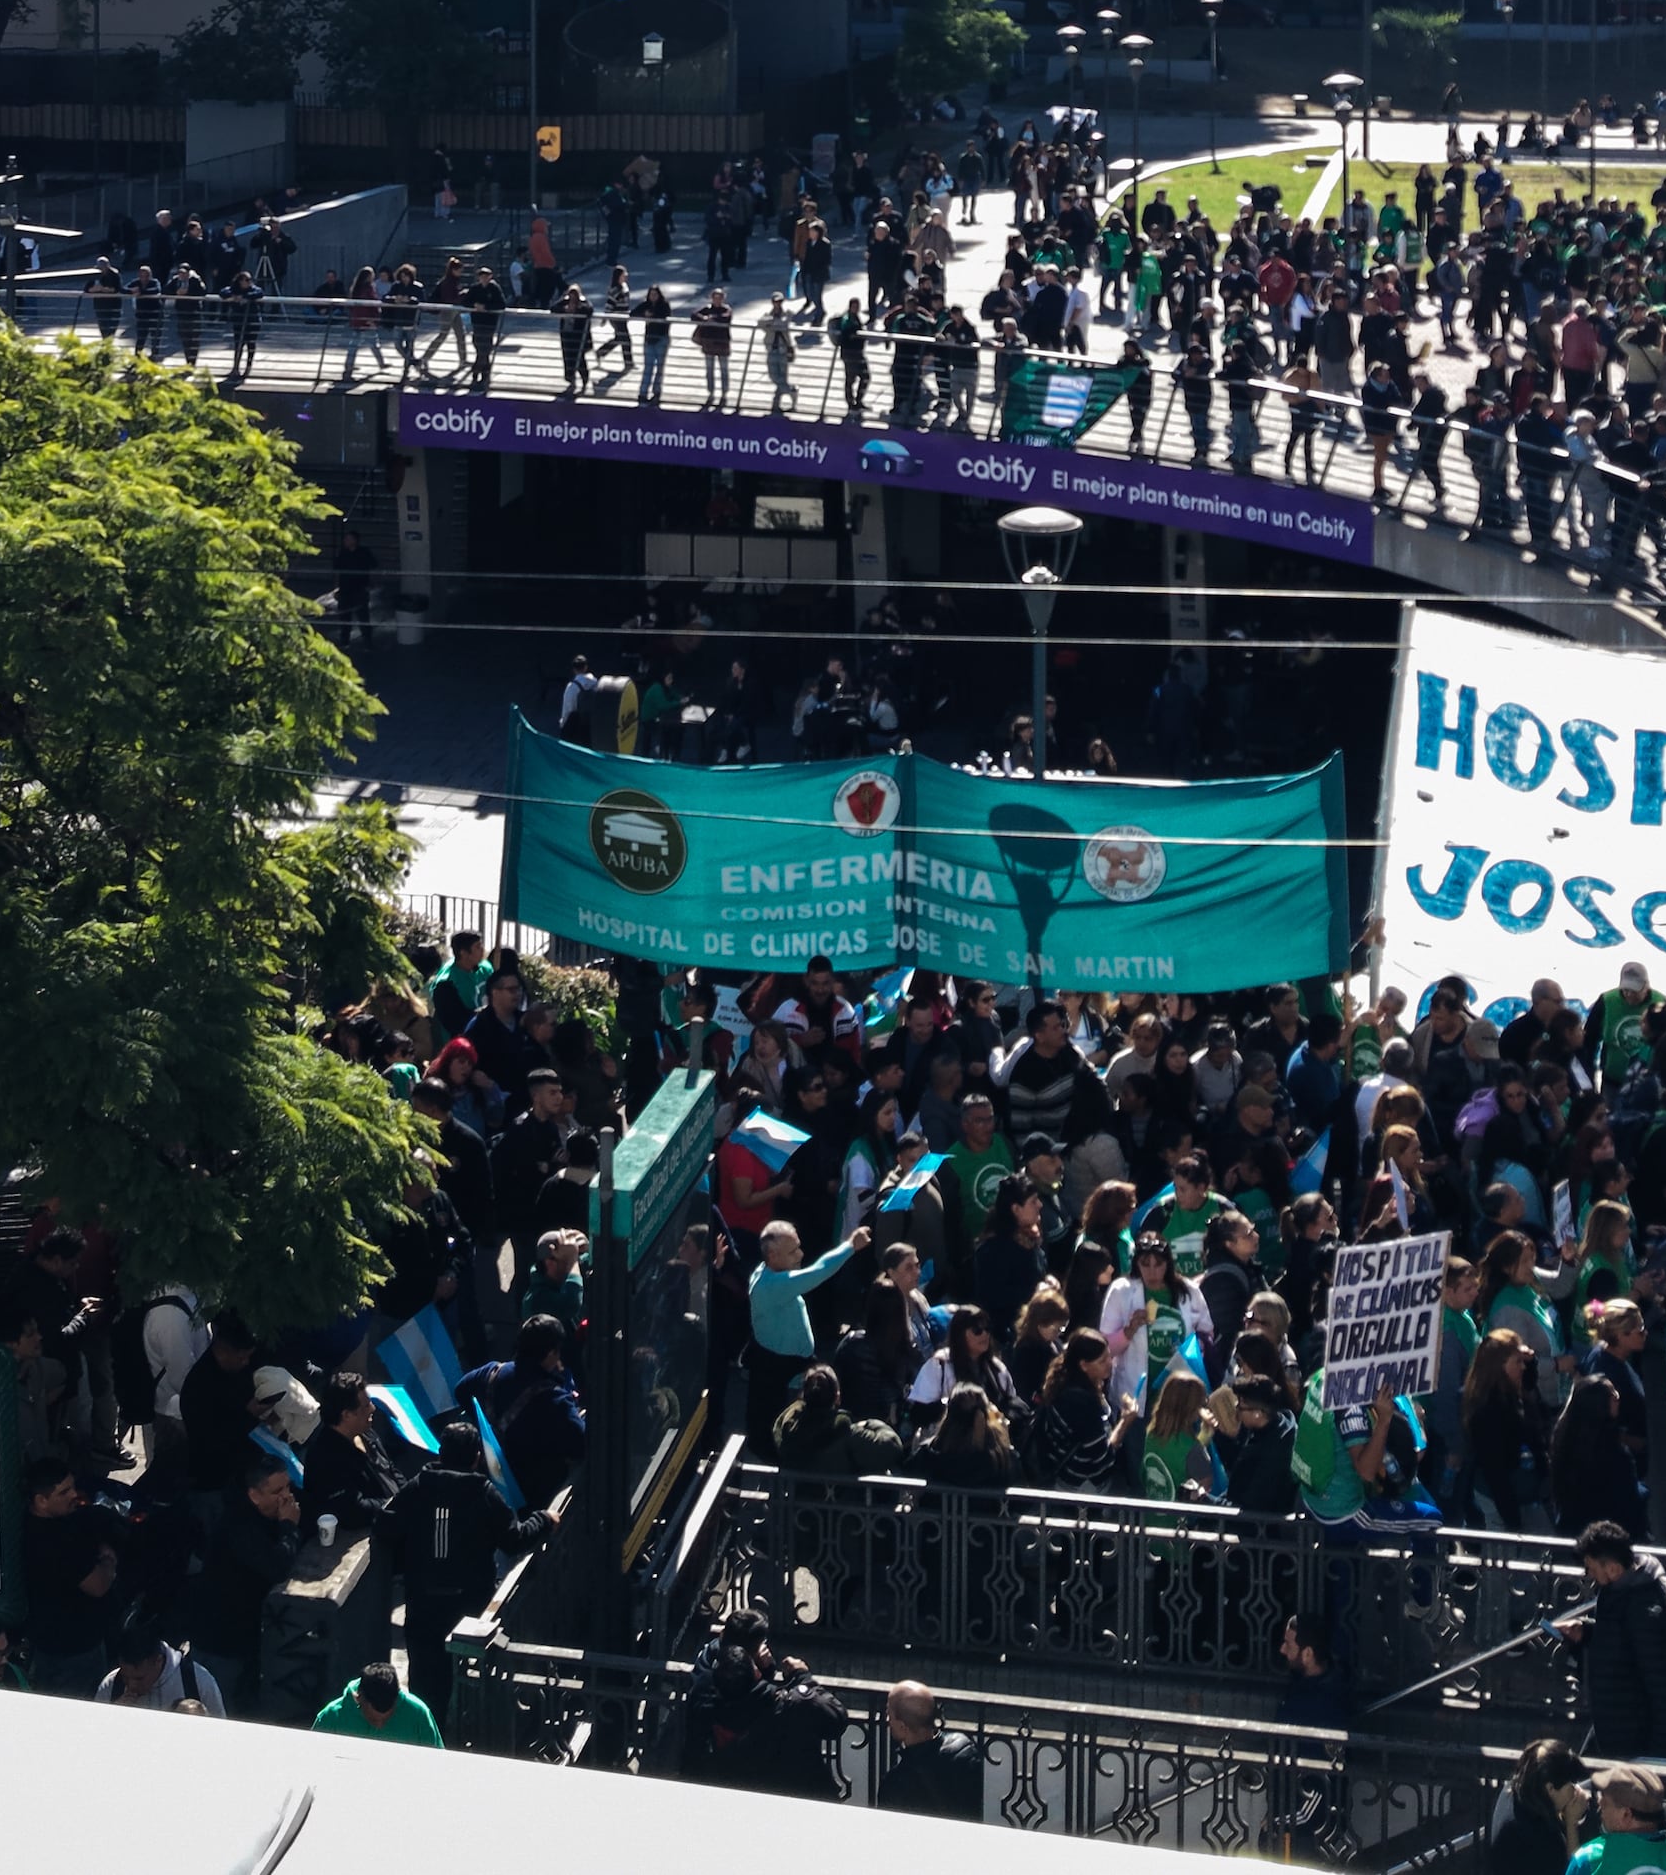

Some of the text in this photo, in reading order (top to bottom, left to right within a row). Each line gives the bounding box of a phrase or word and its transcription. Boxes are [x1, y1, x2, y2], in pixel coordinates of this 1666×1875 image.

[415, 408, 829, 464] cabify El mejor plan termina en un Cabify
[957, 454, 1355, 546] cabify El mejor plan termina en un Cabify
[607, 849, 670, 877] APUBA
[721, 849, 998, 903] ENFERMERIA
[721, 896, 997, 934] COMISION INTERNA
[578, 907, 1176, 980] HOSPITAL DE CLINICAS JOSE DE SAN MARTIN
[1335, 1240, 1444, 1287] HOSPITAL
[1334, 1294, 1355, 1321] DE
[1329, 1310, 1432, 1364] ORGULLO
